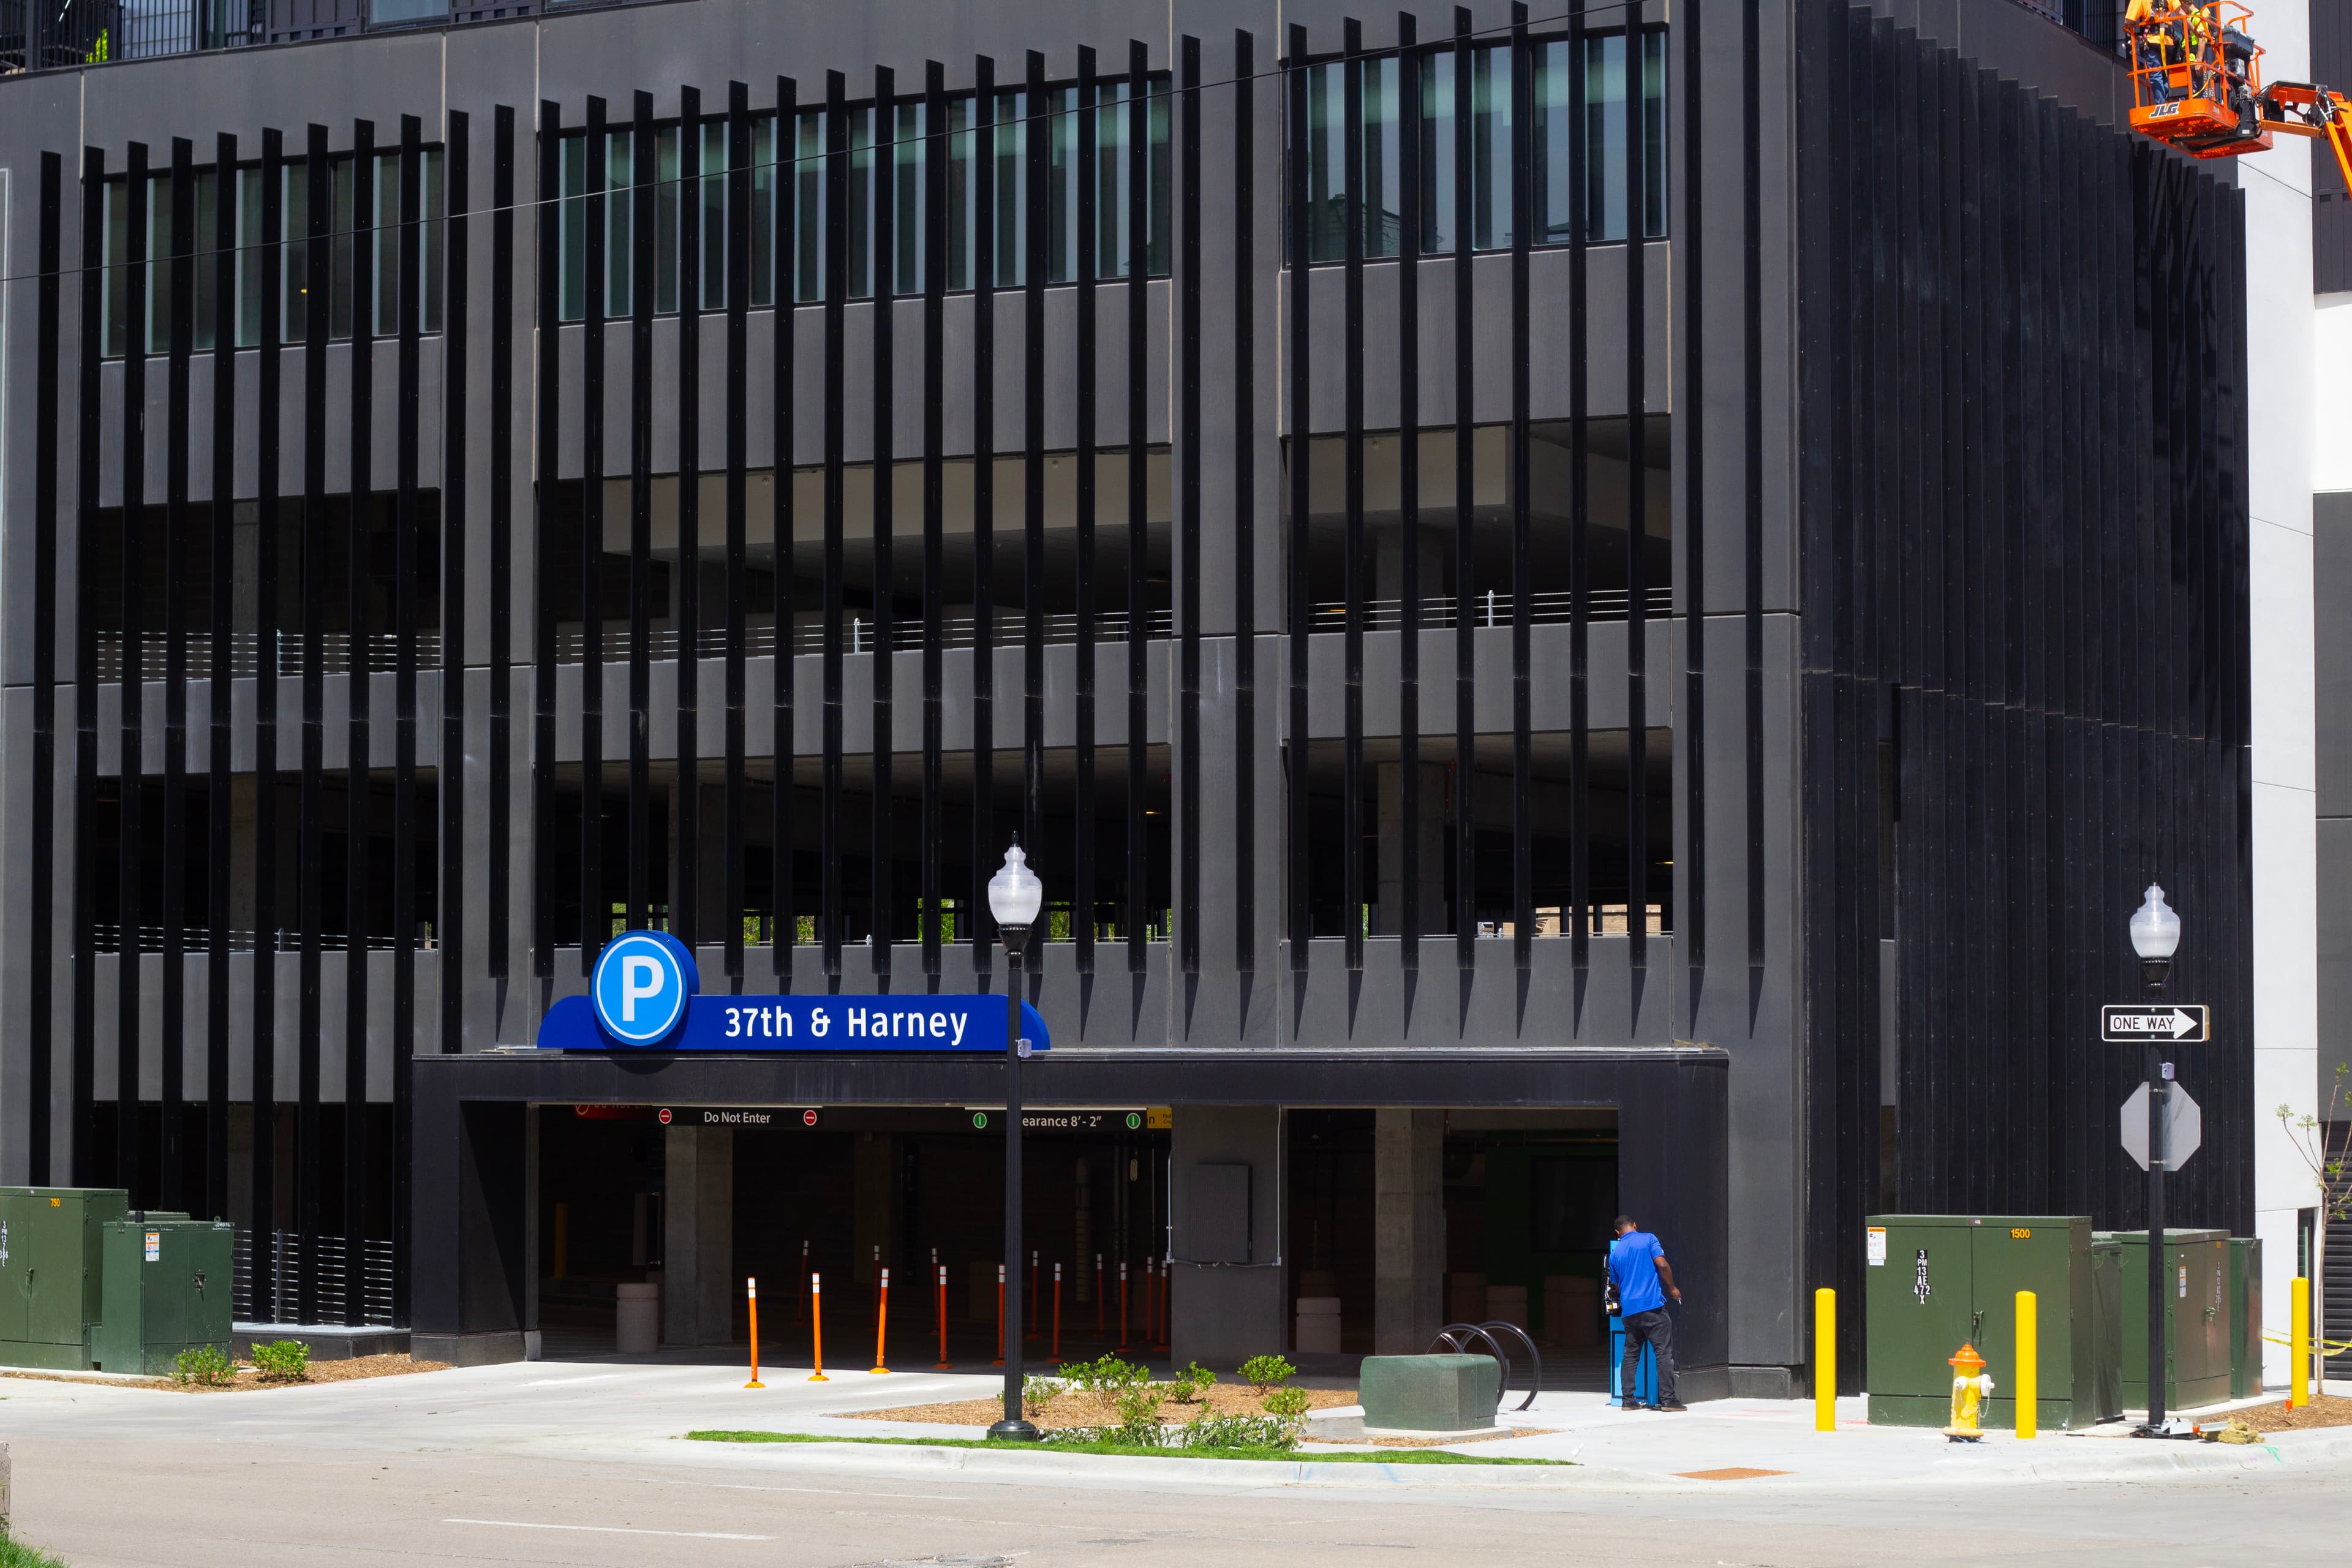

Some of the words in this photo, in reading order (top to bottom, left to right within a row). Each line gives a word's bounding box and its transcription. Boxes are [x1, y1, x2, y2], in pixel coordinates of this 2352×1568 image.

[2150, 103, 2179, 118] JLG
[622, 956, 665, 1022] P
[725, 1006, 793, 1038] 37th
[812, 1007, 831, 1037] &
[848, 1008, 968, 1046] Harney
[2113, 1017, 2141, 1030] ONE
[2147, 1017, 2175, 1030] WAY
[704, 1112, 719, 1123] Do
[722, 1112, 741, 1123] Not
[743, 1112, 771, 1124] Enter
[1022, 1117, 1068, 1127] earance
[51, 1197, 61, 1207] 750
[2010, 1228, 2030, 1239] 1500
[1920, 1250, 1925, 1259] 3
[1917, 1267, 1927, 1276] 13
[1917, 1276, 1928, 1286] AE
[1914, 1285, 1931, 1295] 472
[1920, 1295, 1925, 1305] X
